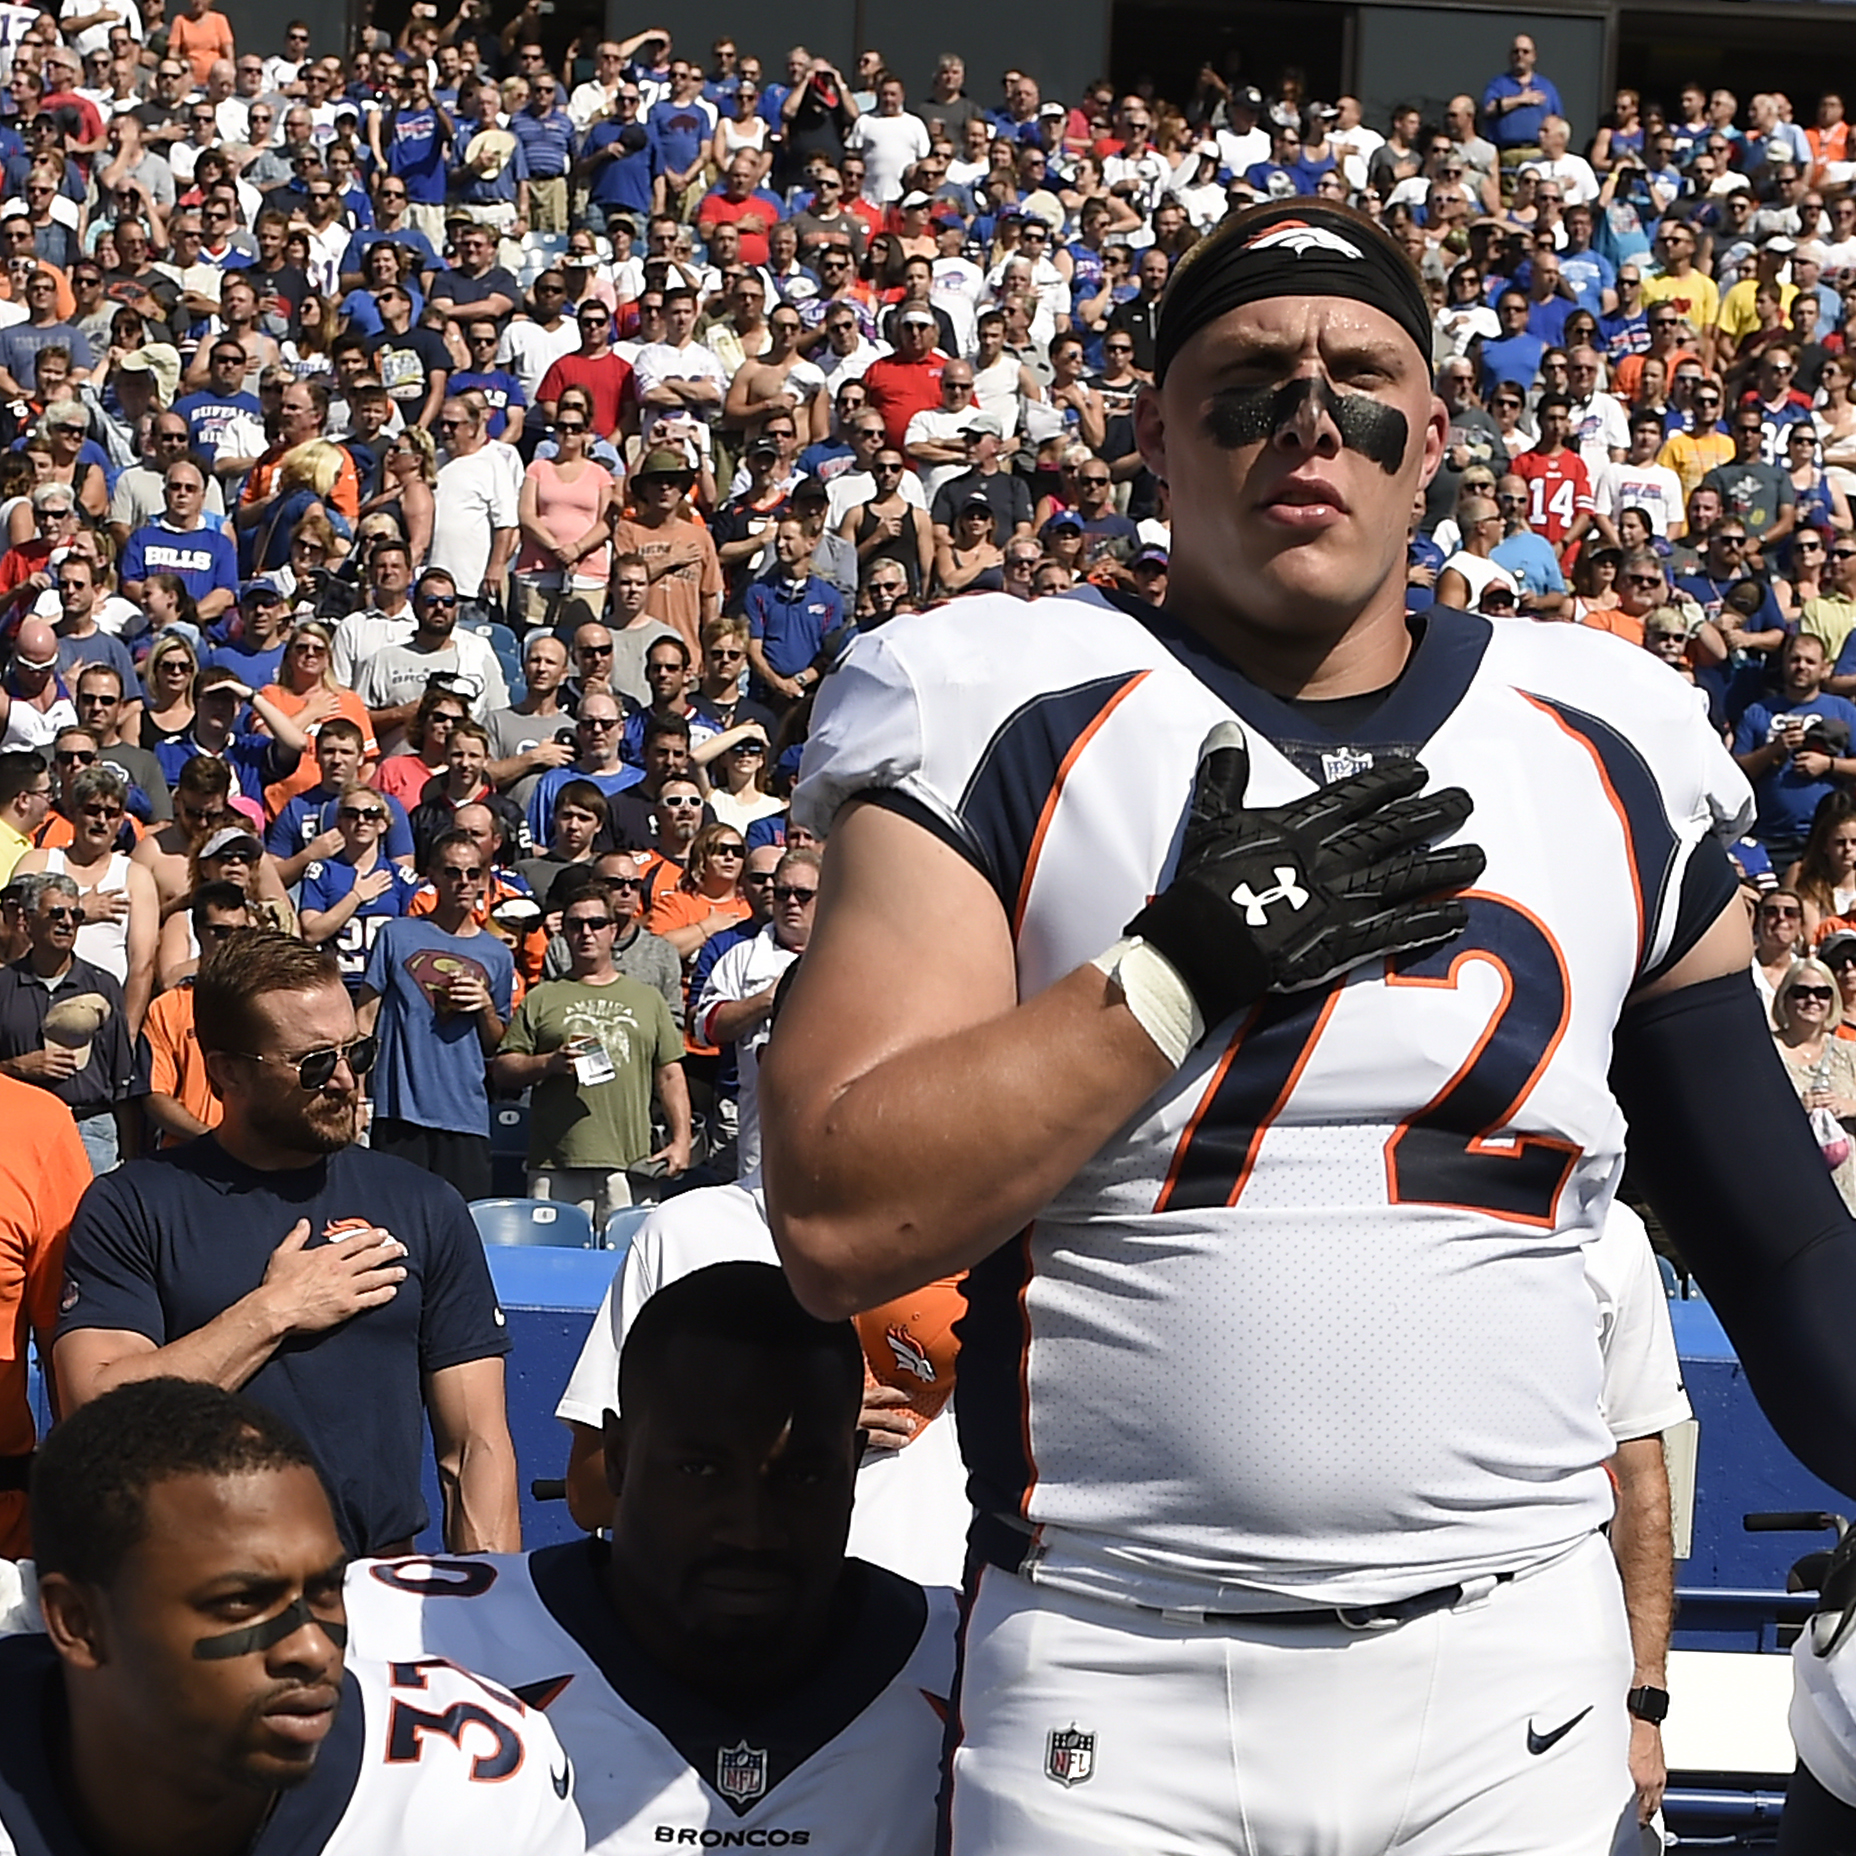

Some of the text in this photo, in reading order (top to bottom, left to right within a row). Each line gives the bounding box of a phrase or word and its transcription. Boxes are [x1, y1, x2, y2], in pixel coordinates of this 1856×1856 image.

[1529, 477, 1575, 529] 14
[143, 542, 211, 572] BILLS
[1054, 1751, 1090, 1779] NFL
[725, 1770, 762, 1795] NFL
[653, 1824, 811, 1850] BRONCOS
